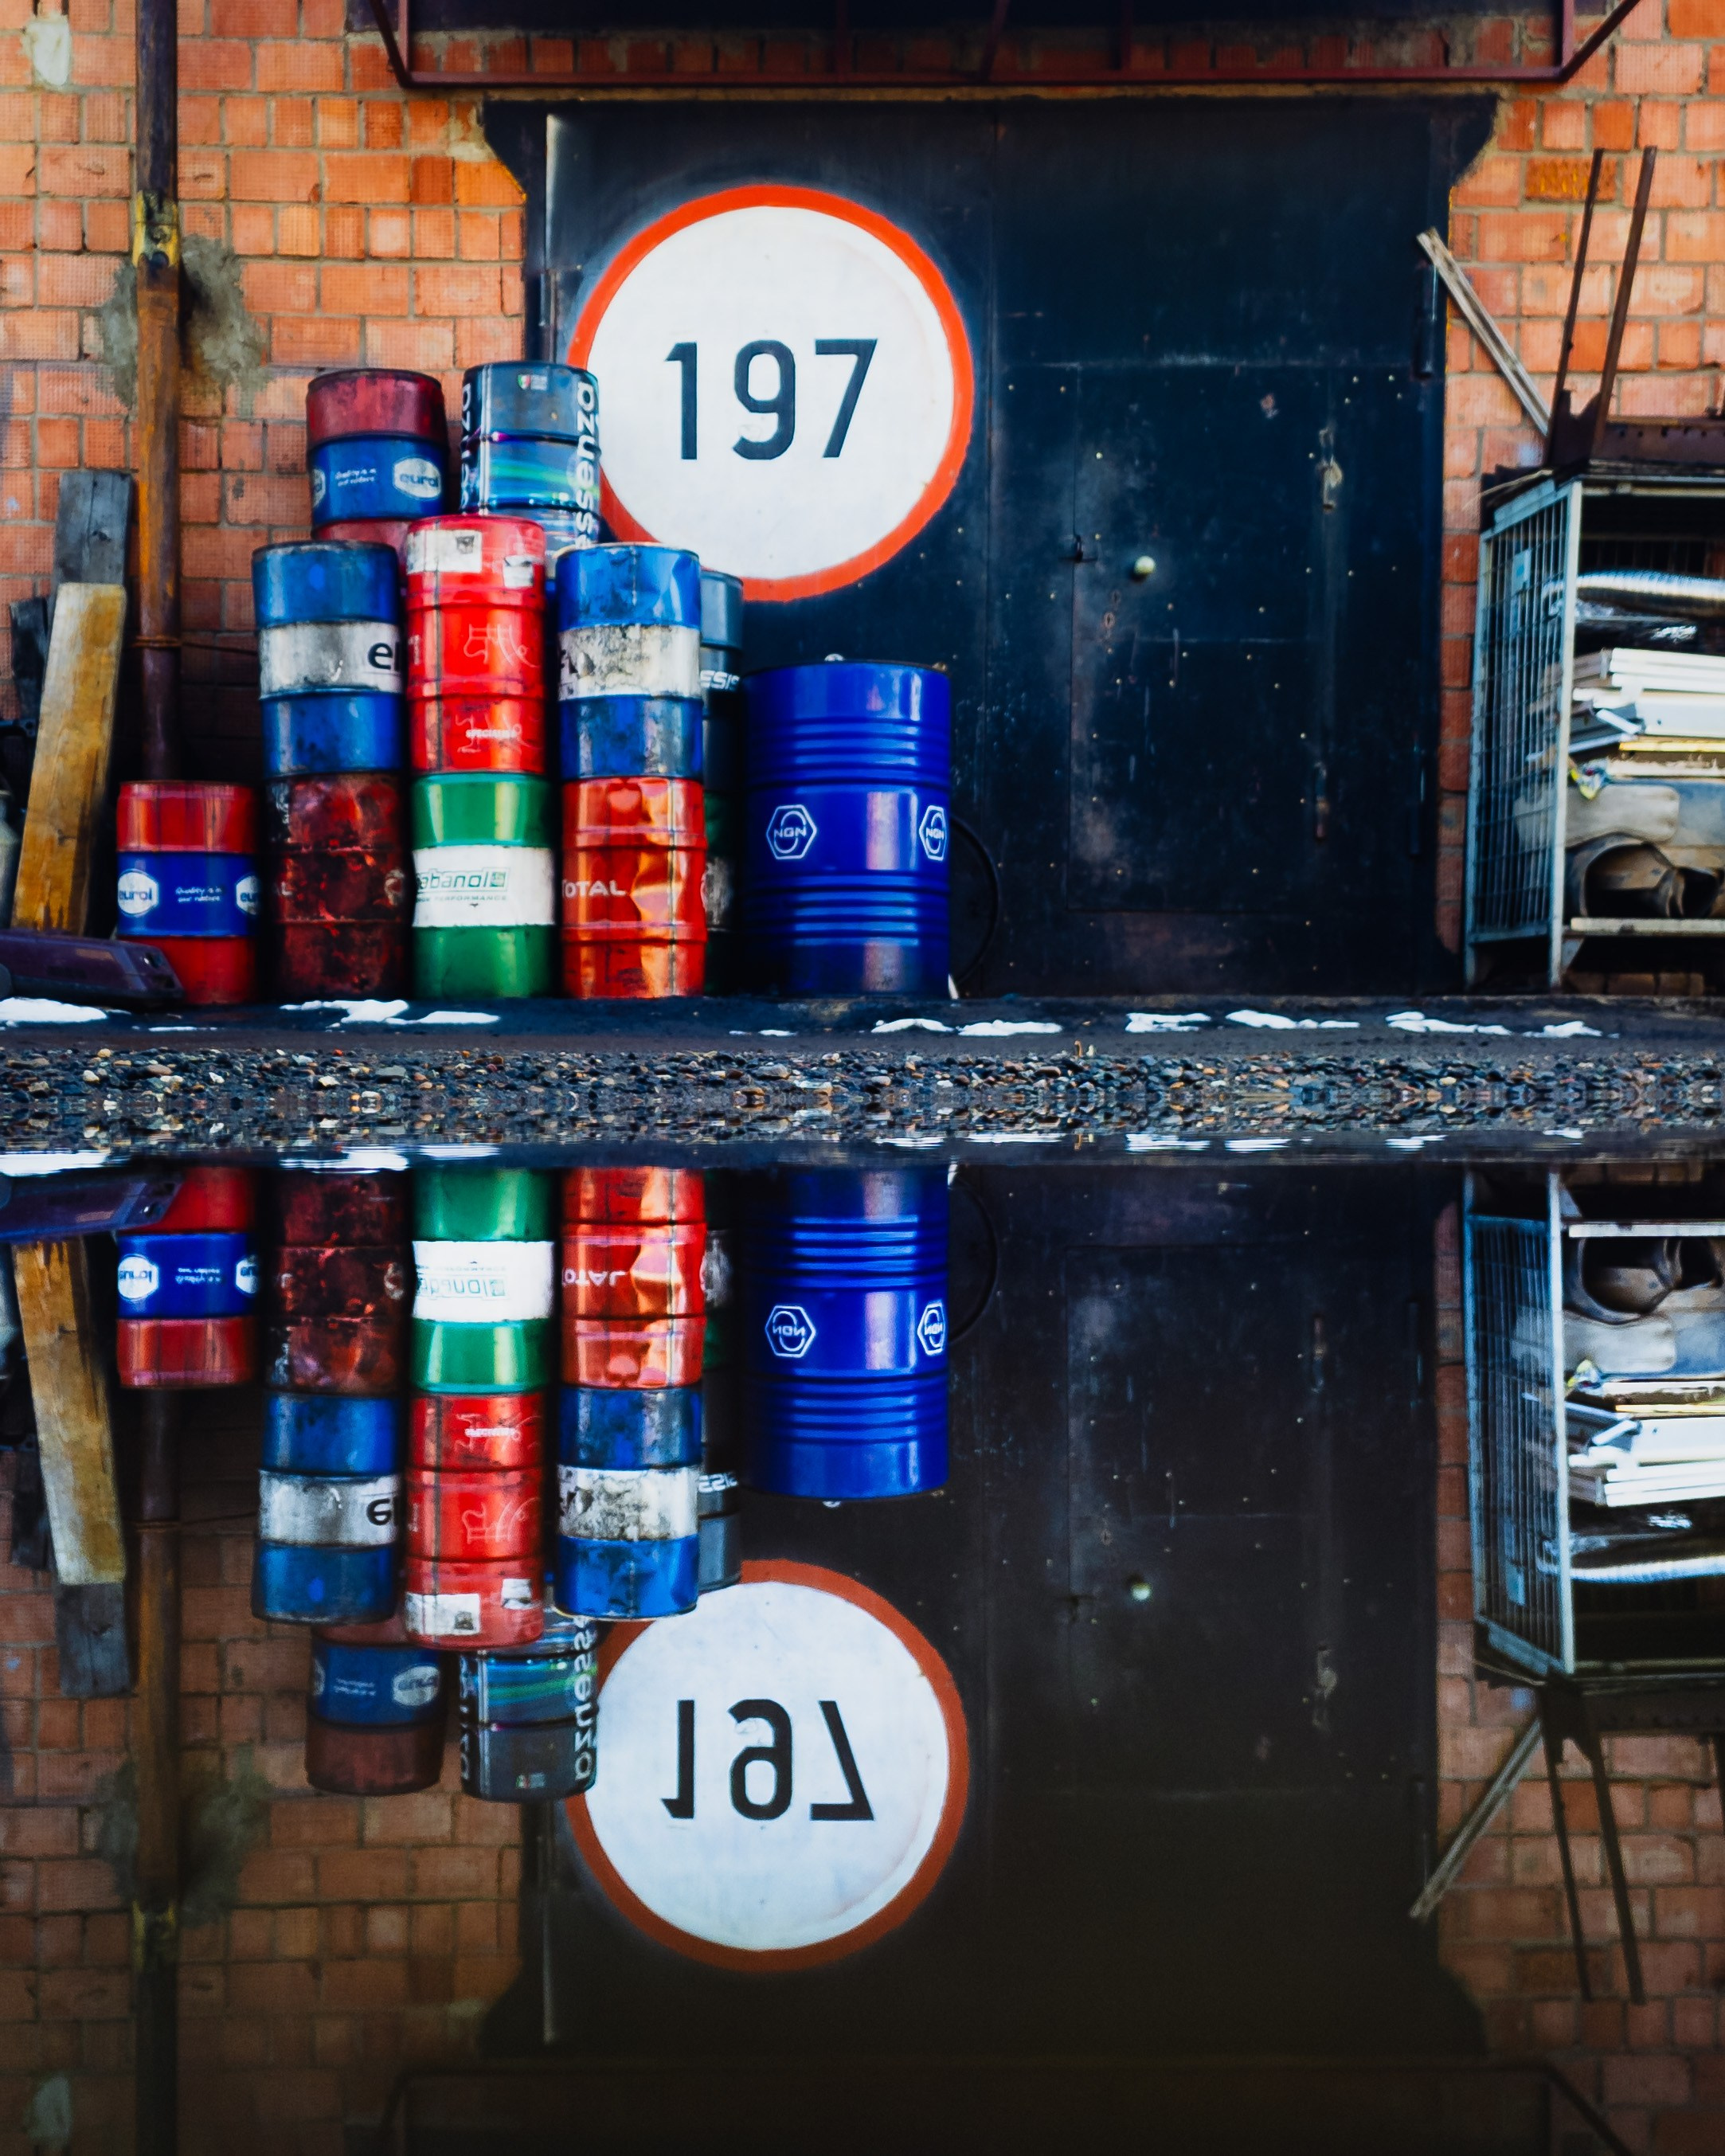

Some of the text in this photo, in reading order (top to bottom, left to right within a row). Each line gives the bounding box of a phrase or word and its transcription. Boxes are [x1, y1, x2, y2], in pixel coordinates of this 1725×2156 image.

[664, 338, 877, 460] 197
[773, 827, 807, 838] NGN
[119, 886, 152, 901] eurol
